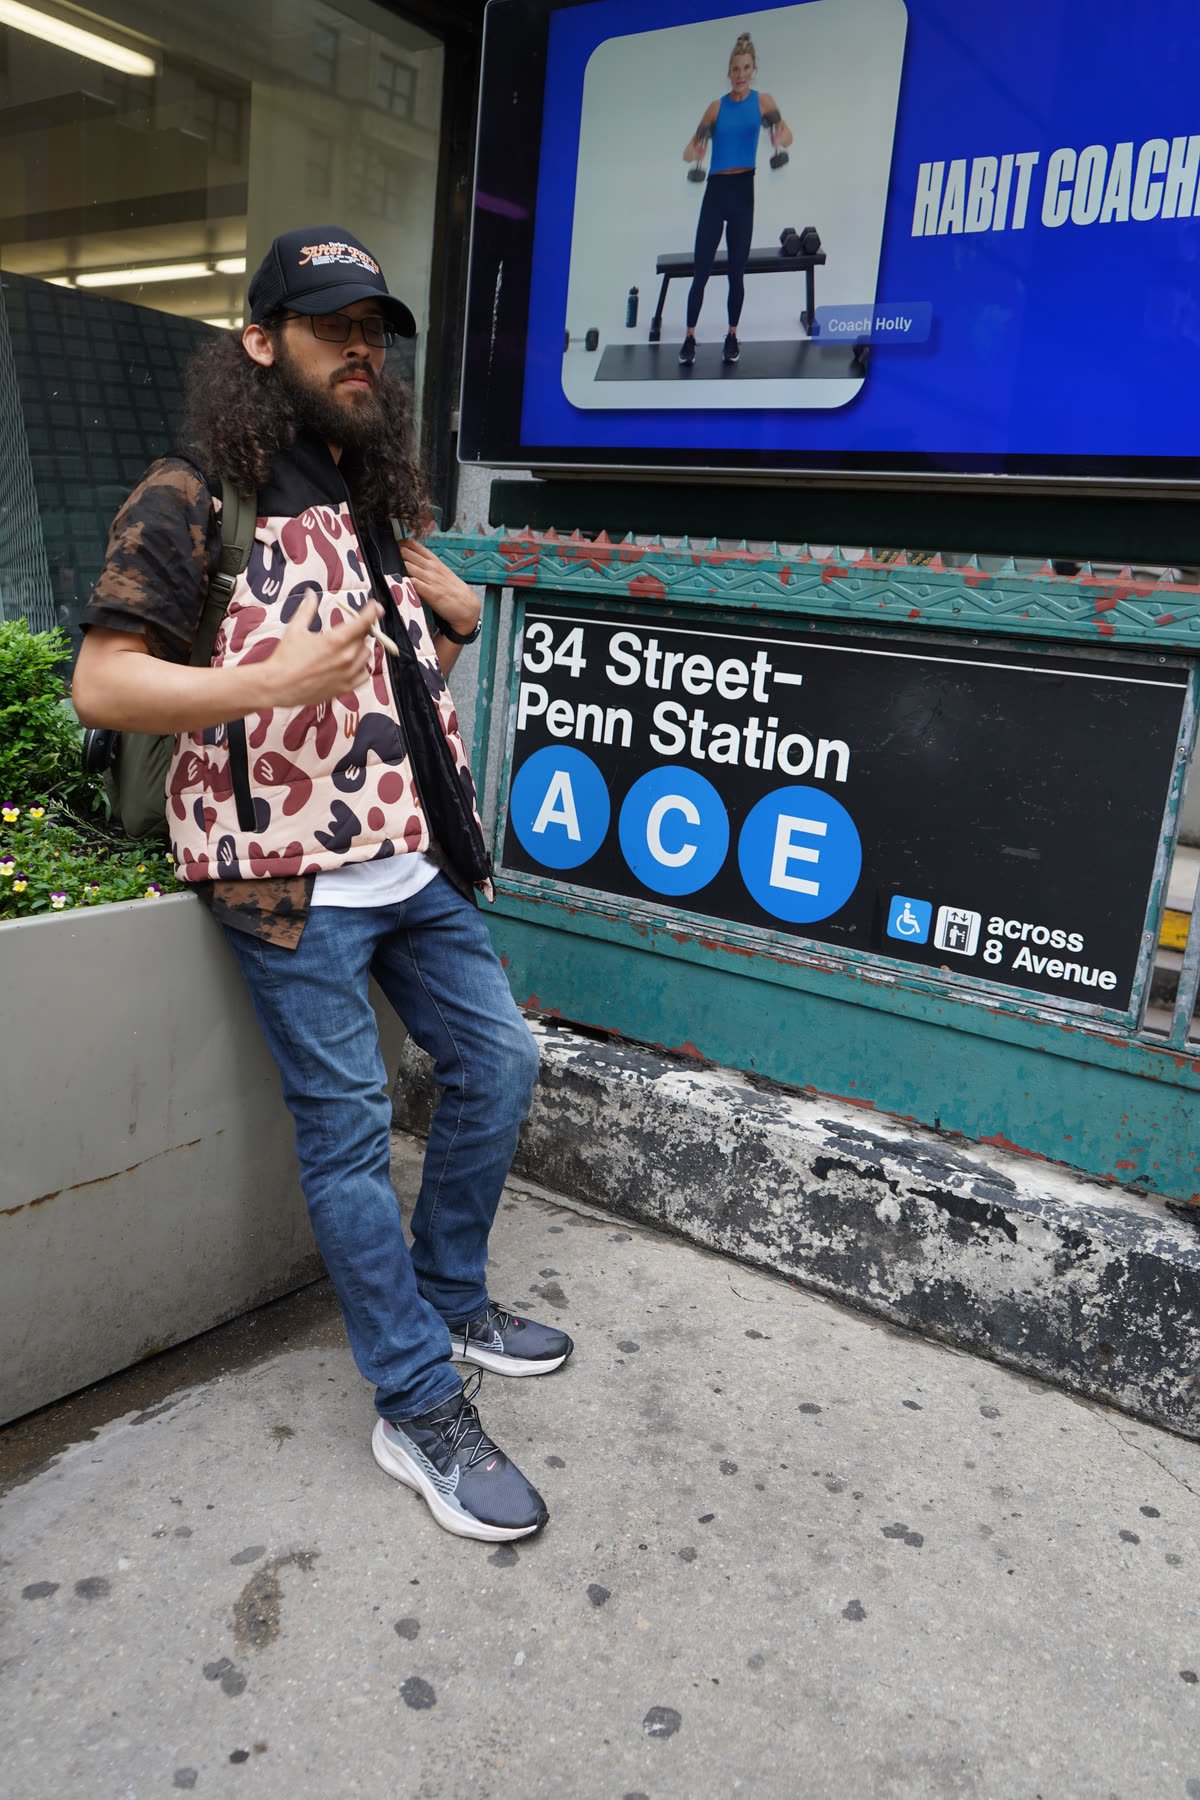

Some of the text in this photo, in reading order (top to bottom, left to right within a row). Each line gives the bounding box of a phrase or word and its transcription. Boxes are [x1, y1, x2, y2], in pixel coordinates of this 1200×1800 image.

[911, 134, 1200, 237] HABIT COACH
[298, 244, 346, 265] After
[828, 316, 912, 332] Coach Holly
[523, 622, 803, 703] 34 Street-
[516, 681, 850, 783] Penn Station
[532, 770, 828, 897] A C E
[983, 939, 1118, 990] 8 Avenue
[987, 916, 1084, 953] across
